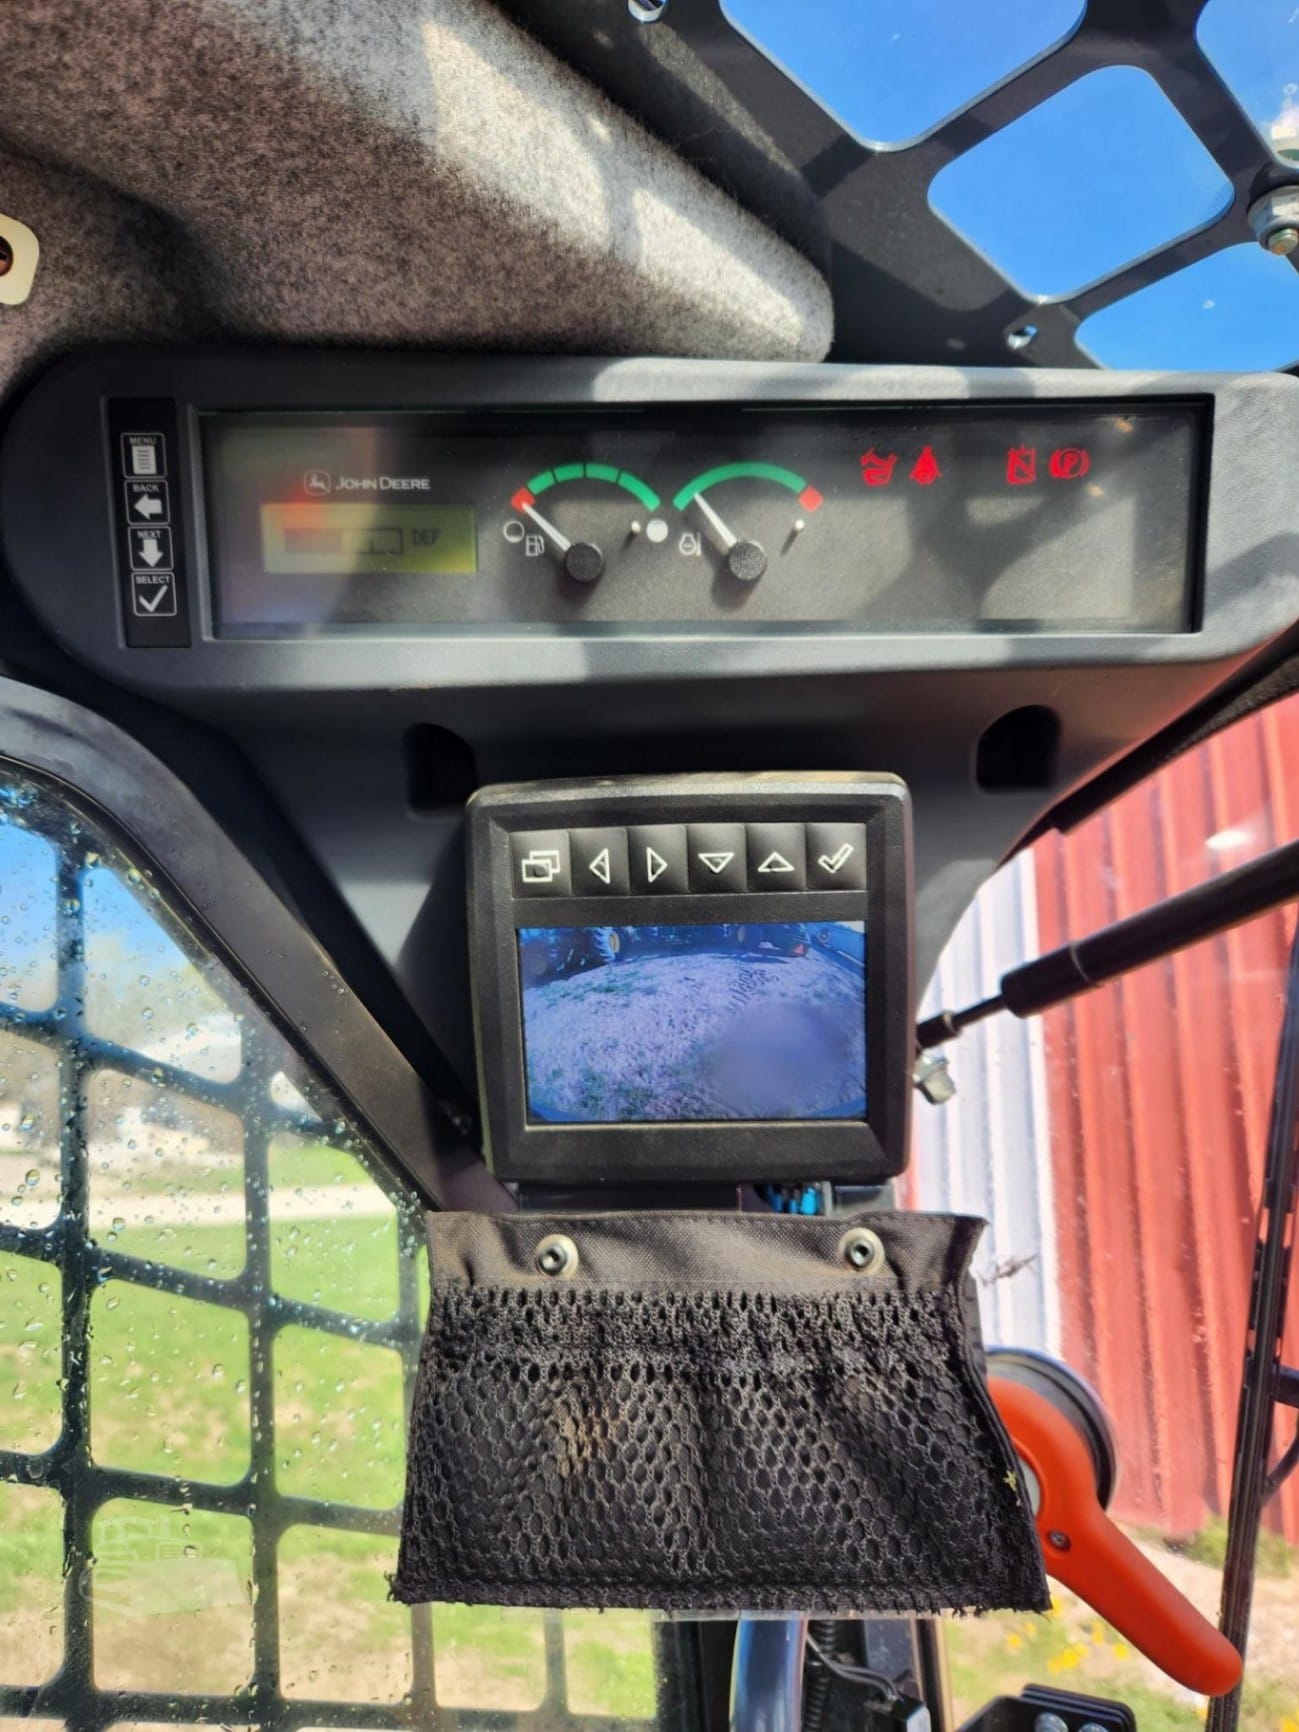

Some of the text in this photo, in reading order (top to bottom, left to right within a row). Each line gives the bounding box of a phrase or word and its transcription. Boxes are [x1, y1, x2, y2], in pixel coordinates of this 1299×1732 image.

[129, 436, 157, 445] MENU
[335, 476, 431, 490] JOHN DEERE
[132, 484, 160, 493] BACK
[137, 530, 161, 539] NEXT
[412, 528, 441, 545] DEF
[135, 575, 170, 585] SELECT
